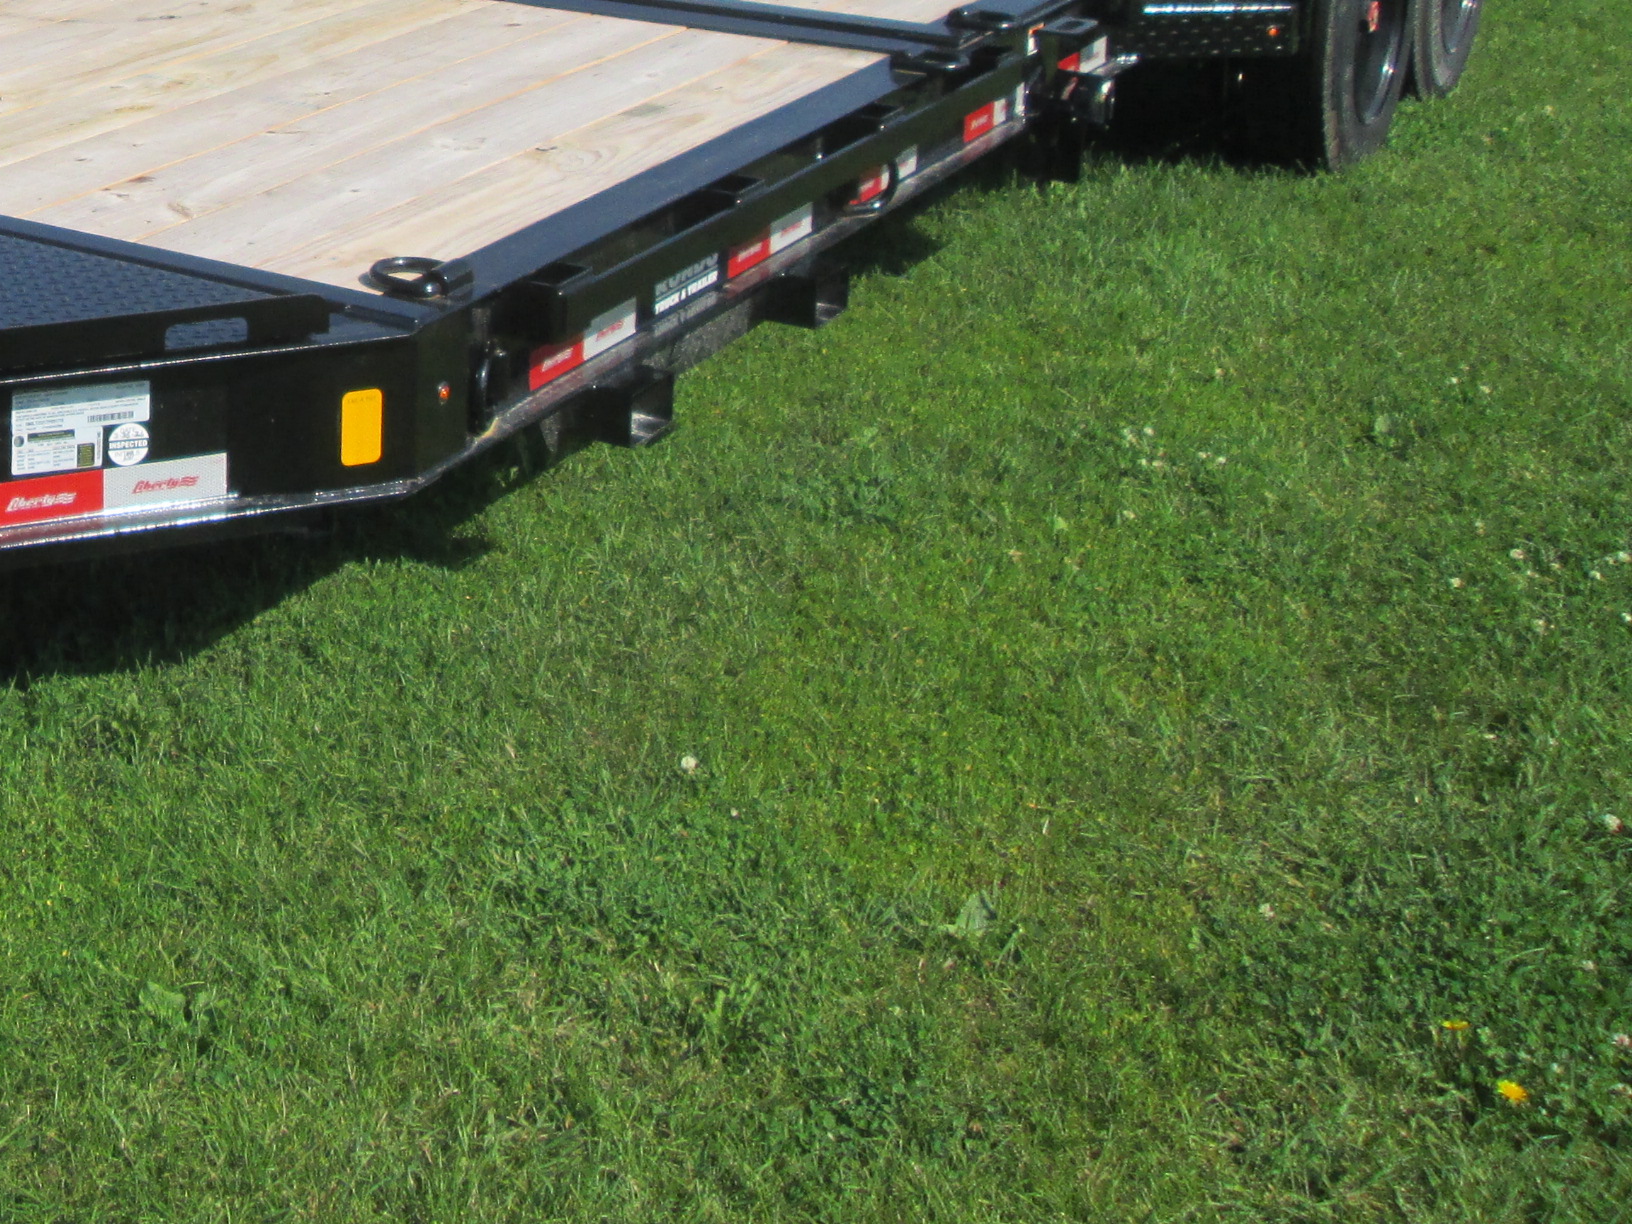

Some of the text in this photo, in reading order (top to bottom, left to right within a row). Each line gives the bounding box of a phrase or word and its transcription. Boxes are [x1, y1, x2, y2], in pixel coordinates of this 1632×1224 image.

[109, 439, 148, 450] INSPECTED
[132, 476, 182, 494] Liberty
[5, 495, 60, 513] Liberty
